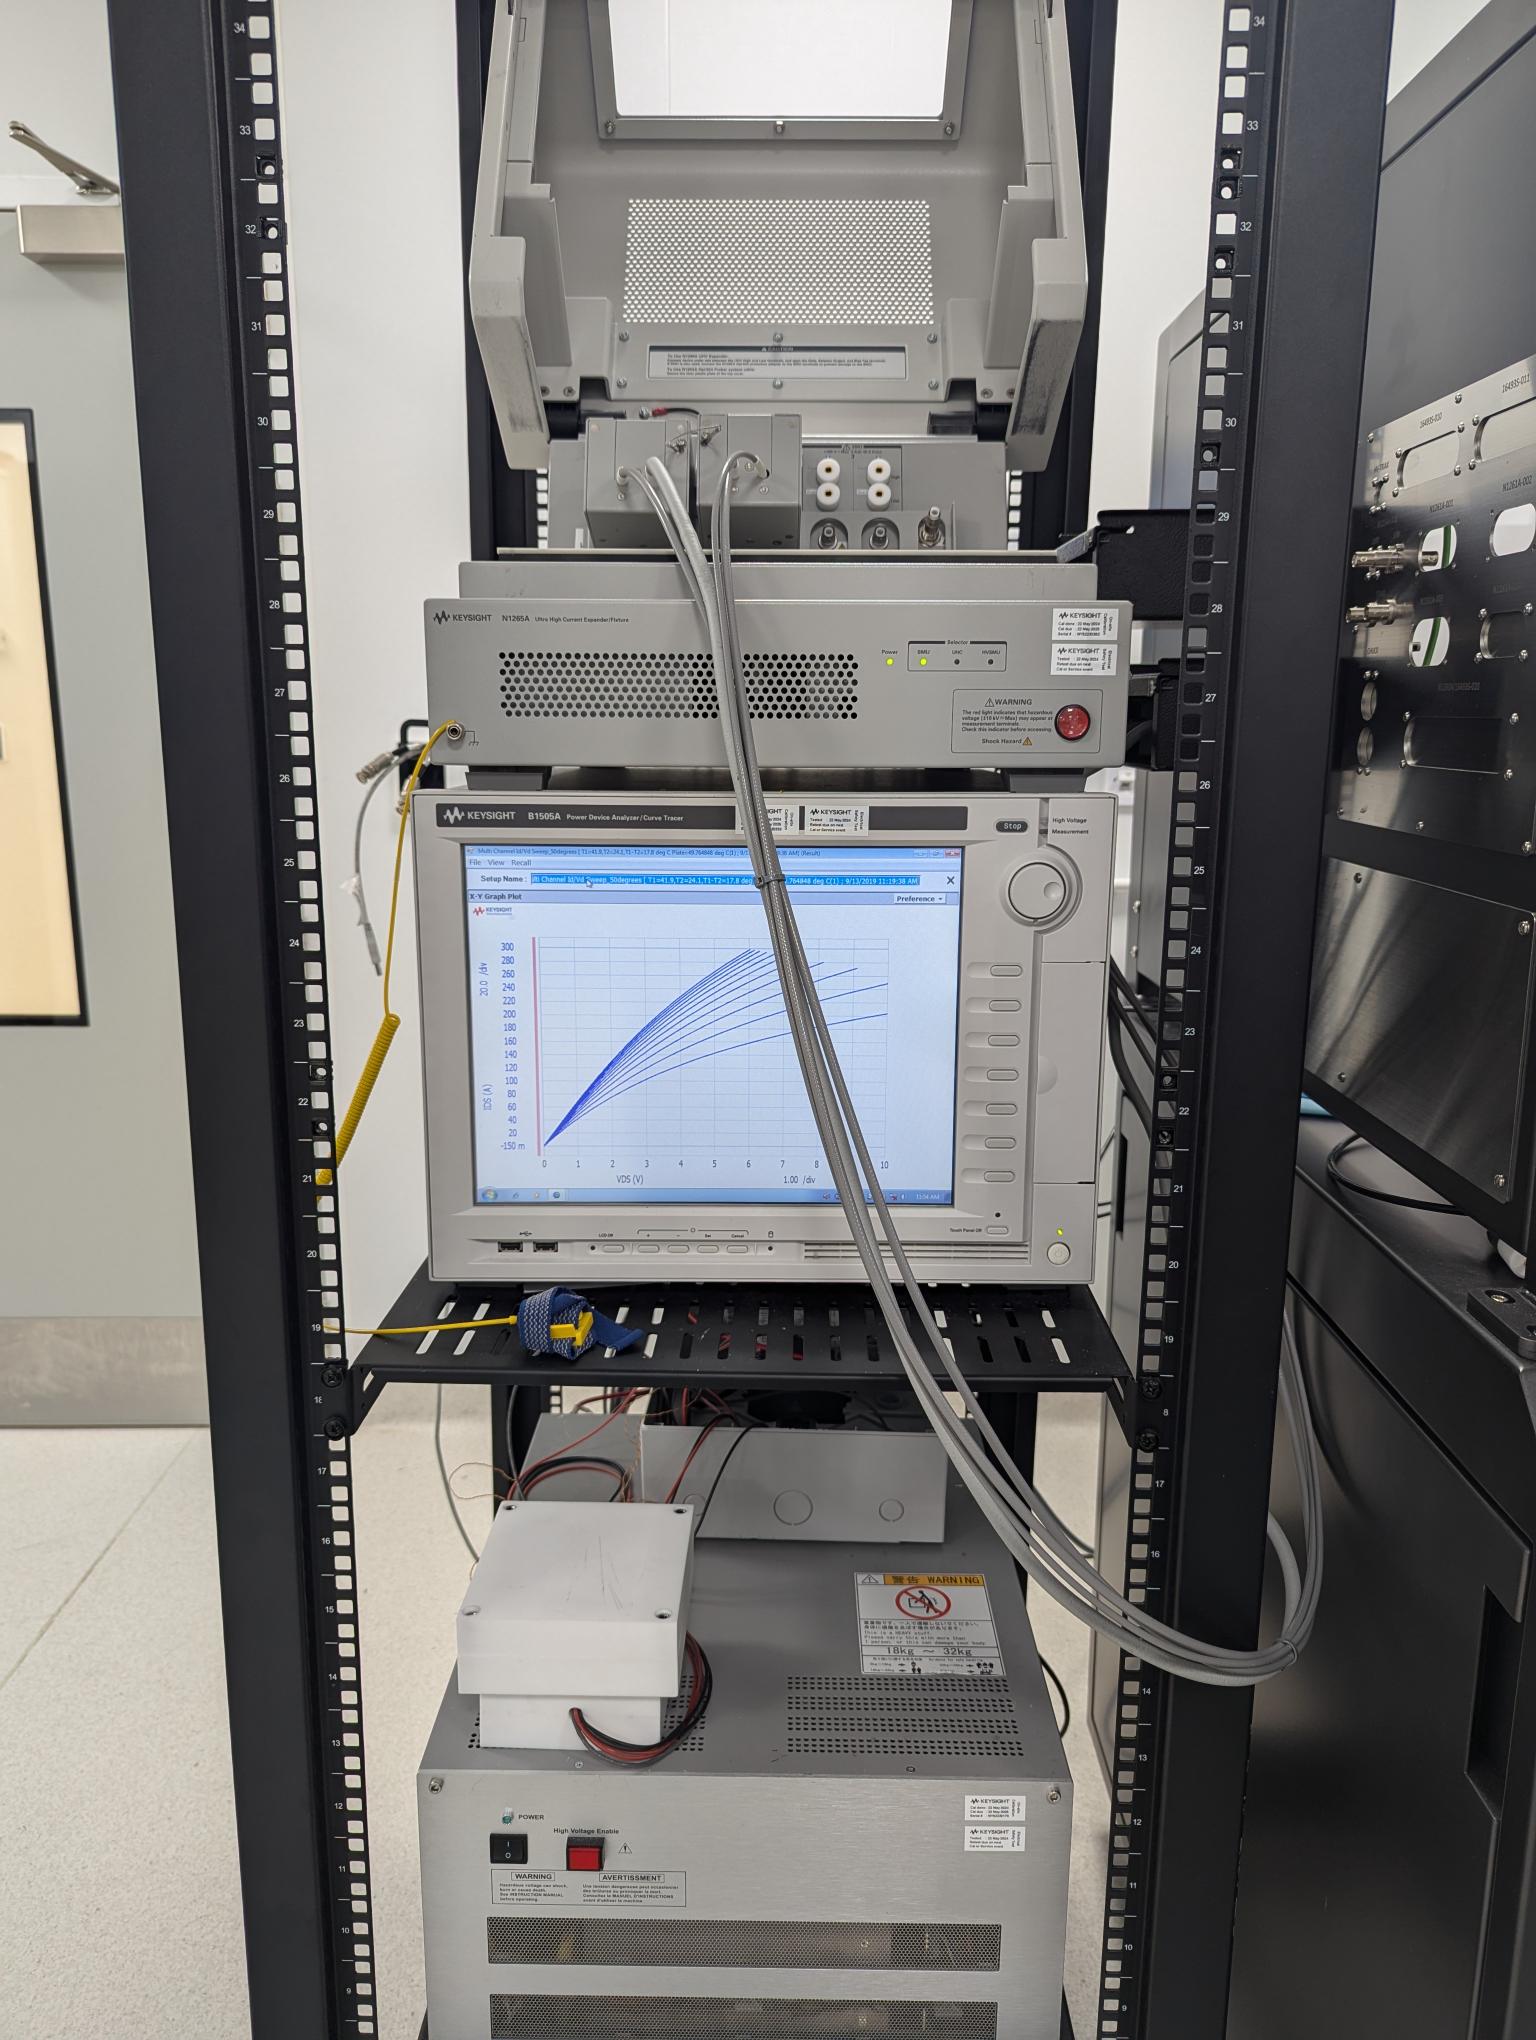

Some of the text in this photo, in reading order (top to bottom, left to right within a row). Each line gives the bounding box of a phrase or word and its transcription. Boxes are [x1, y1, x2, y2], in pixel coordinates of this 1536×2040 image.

[1254, 16, 1265, 26] 34
[234, 23, 245, 33] 34
[1247, 121, 1258, 130] 33
[240, 125, 251, 135] 33
[245, 225, 256, 234] 32
[1240, 222, 1251, 231] 32
[252, 322, 261, 331] 31
[1233, 321, 1243, 330] 31
[258, 417, 268, 426] 30
[1225, 418, 1236, 427] 30
[264, 510, 274, 518] 29
[1218, 512, 1229, 521] 29
[269, 600, 280, 609] 28
[1211, 604, 1222, 613] 28
[452, 614, 492, 622] KEYSIGHT
[275, 688, 285, 697] 27
[995, 698, 1032, 706] WARNING
[1205, 694, 1216, 702] 27
[280, 774, 290, 782] 26
[1200, 781, 1210, 789] 26
[467, 811, 684, 822] KEYSIGHT B1505A Power Device Analyzer/Curve Tracer
[284, 858, 294, 866] 25
[1194, 866, 1204, 874] 25
[481, 875, 501, 884] Setup
[484, 893, 506, 902] Graph
[289, 939, 299, 947] 24
[501, 943, 514, 951] 300
[1191, 946, 1201, 954] 24
[501, 956, 514, 964] 280
[502, 970, 515, 978] 260
[480, 980, 488, 996] 20.0
[503, 983, 515, 991] 240
[503, 997, 515, 1005] 220
[504, 1010, 516, 1018] 200
[294, 1019, 304, 1027] 23
[504, 1023, 516, 1031] 180
[505, 1037, 517, 1045] 160
[505, 1050, 517, 1058] 140
[482, 1084, 493, 1110] IDS (A)
[1179, 1107, 1189, 1115] 22
[508, 1116, 516, 1124] 40
[501, 1142, 516, 1150] -150
[542, 1160, 547, 1168] 0
[576, 1160, 580, 1168] 1
[610, 1160, 615, 1168] 2
[645, 1160, 649, 1168] 3
[679, 1160, 683, 1168] 4
[712, 1160, 717, 1168] 5
[747, 1160, 751, 1168] 6
[780, 1160, 785, 1168] 7
[814, 1160, 819, 1168] 8
[881, 1161, 888, 1169] 10
[616, 1175, 644, 1185] VDS (V)
[783, 1176, 816, 1184] 1.00 /div
[927, 1576, 980, 1584] WARNING
[887, 1647, 972, 1656] 18kg 32kg
